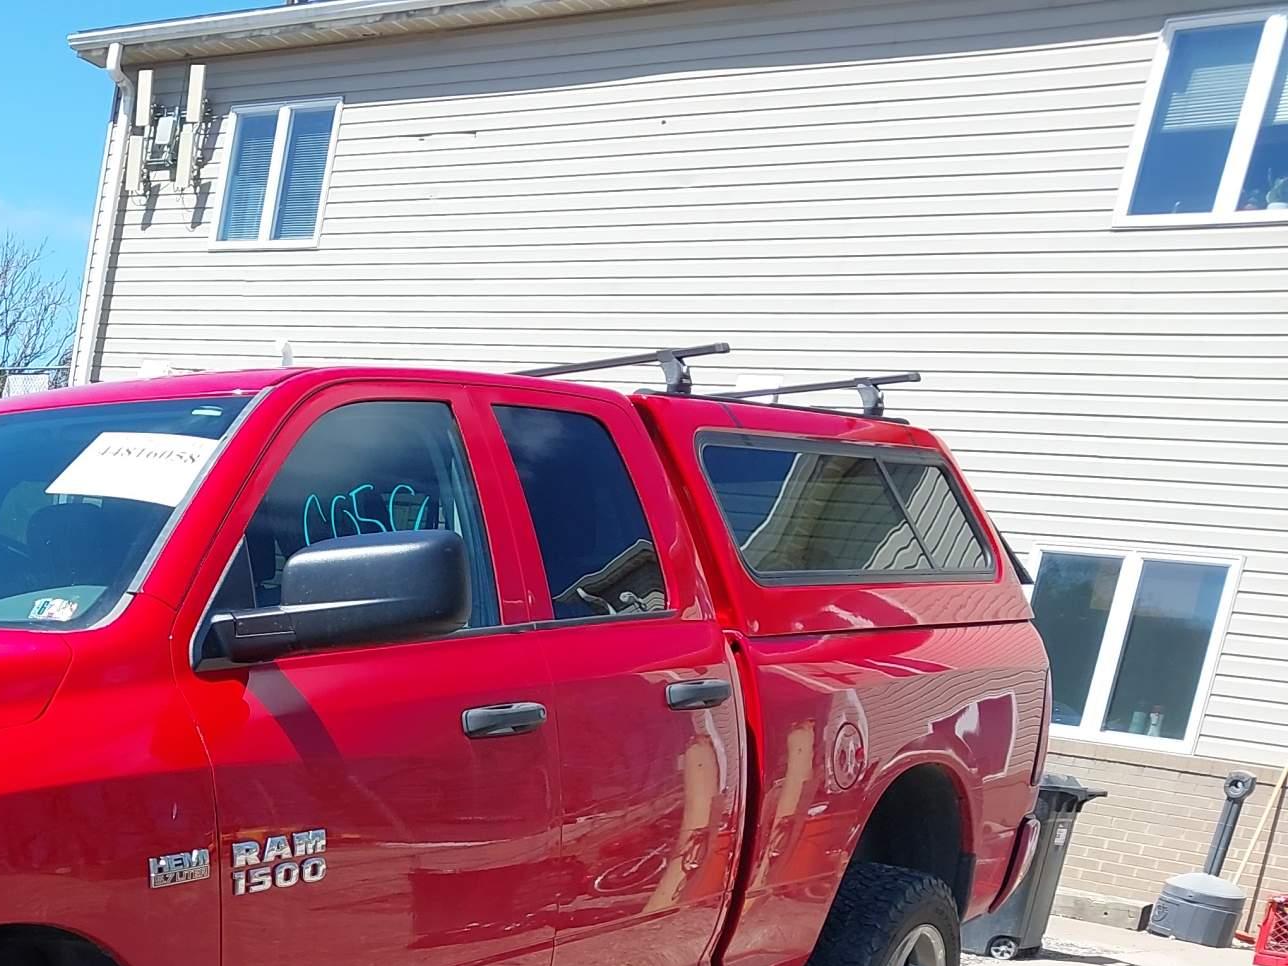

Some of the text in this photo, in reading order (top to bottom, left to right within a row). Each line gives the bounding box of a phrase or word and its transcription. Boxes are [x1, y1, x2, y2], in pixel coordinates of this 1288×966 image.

[148, 848, 210, 875] HEMI
[231, 828, 327, 868] RAM
[232, 857, 327, 896] 1500
